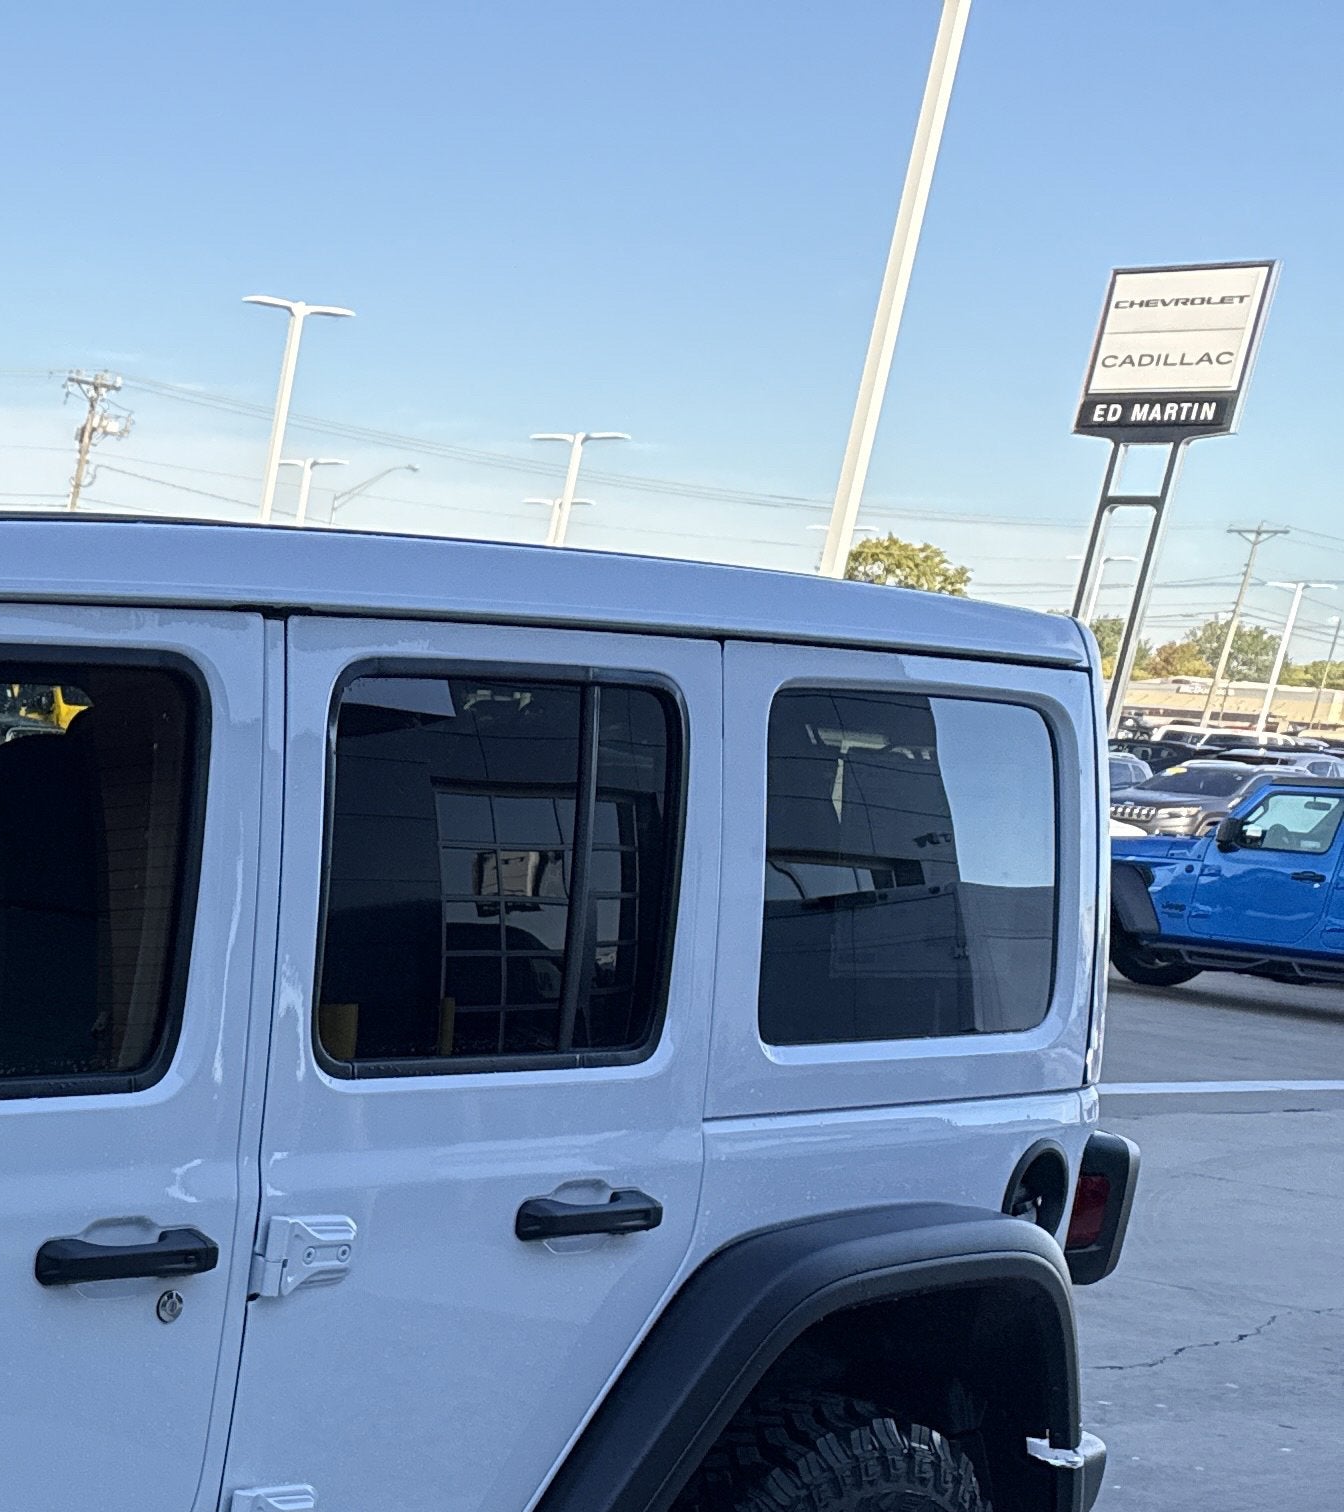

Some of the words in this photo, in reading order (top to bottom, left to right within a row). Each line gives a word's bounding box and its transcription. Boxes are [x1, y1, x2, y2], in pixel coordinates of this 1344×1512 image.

[1113, 294, 1250, 310] CHEVROLET
[1101, 350, 1235, 369] CADILLAC
[1092, 403, 1122, 423] ED
[1130, 401, 1217, 423] MARTIN
